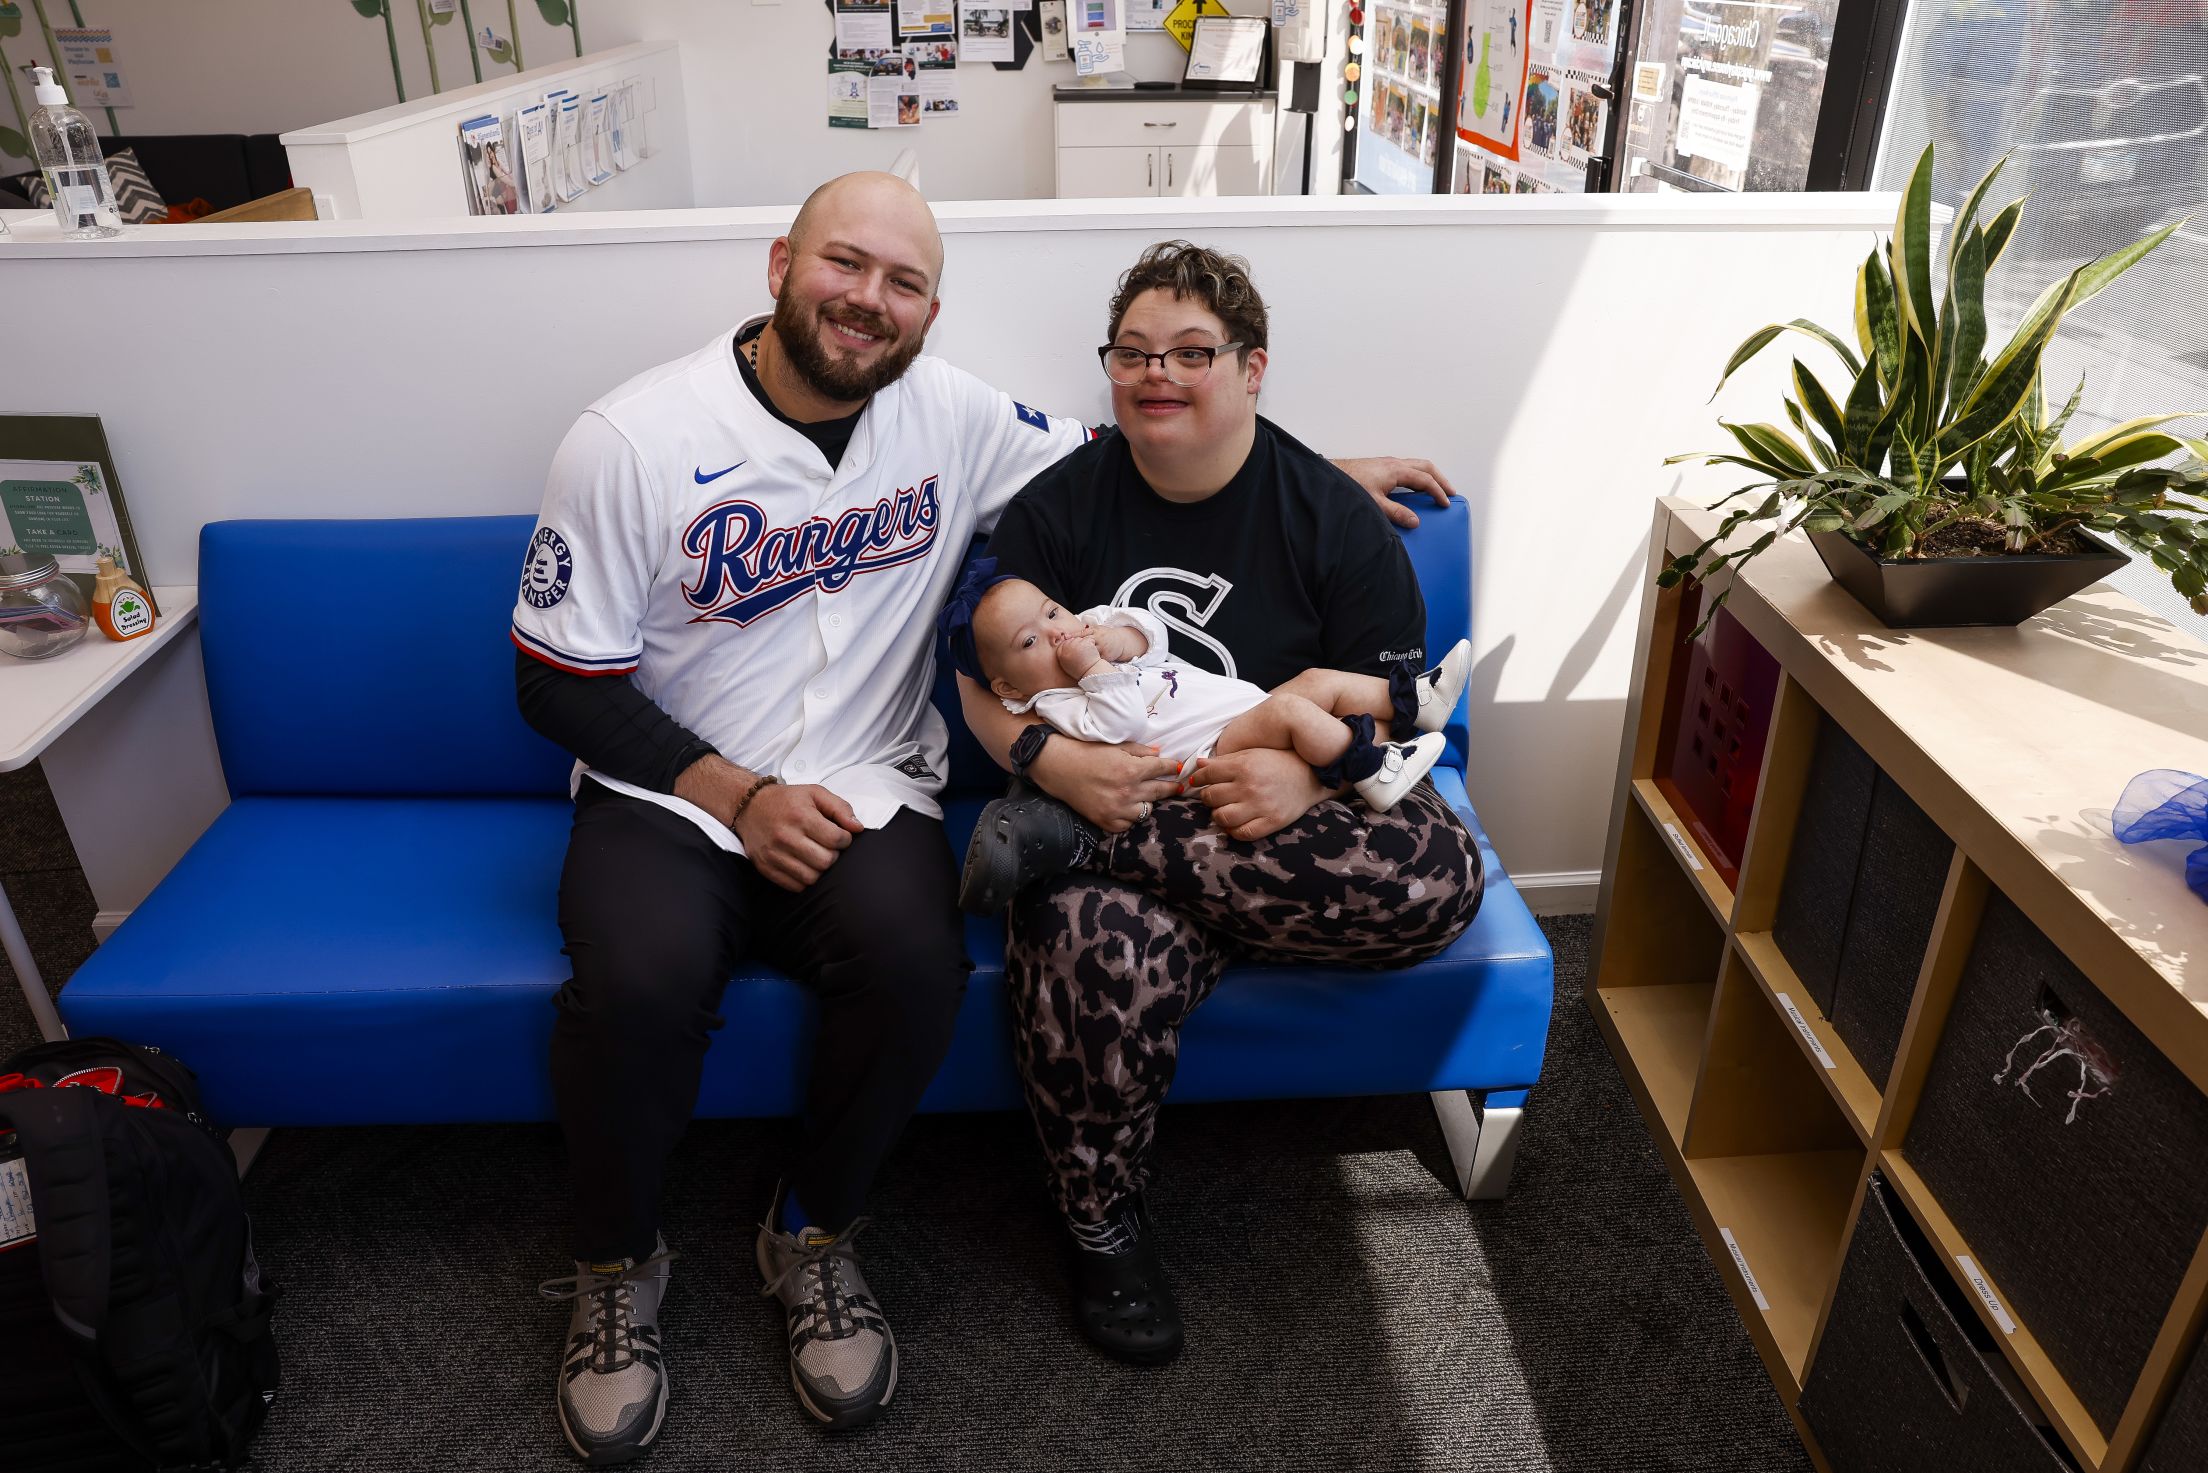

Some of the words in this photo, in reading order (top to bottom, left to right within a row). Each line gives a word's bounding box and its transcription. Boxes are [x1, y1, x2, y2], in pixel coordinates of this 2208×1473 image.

[1172, 19, 1193, 29] PROC
[533, 529, 571, 568] ENERGY
[682, 474, 941, 612] Rangers
[522, 562, 568, 607] TRANSFER
[121, 617, 147, 630] Dressing
[123, 612, 140, 623] Salad
[1788, 1007, 1804, 1025] Musical
[1800, 1024, 1822, 1053] Instruments
[1729, 1243, 1743, 1263] Musical
[1973, 1278, 1991, 1299] Dress
[1988, 1299, 1999, 1311] Up
